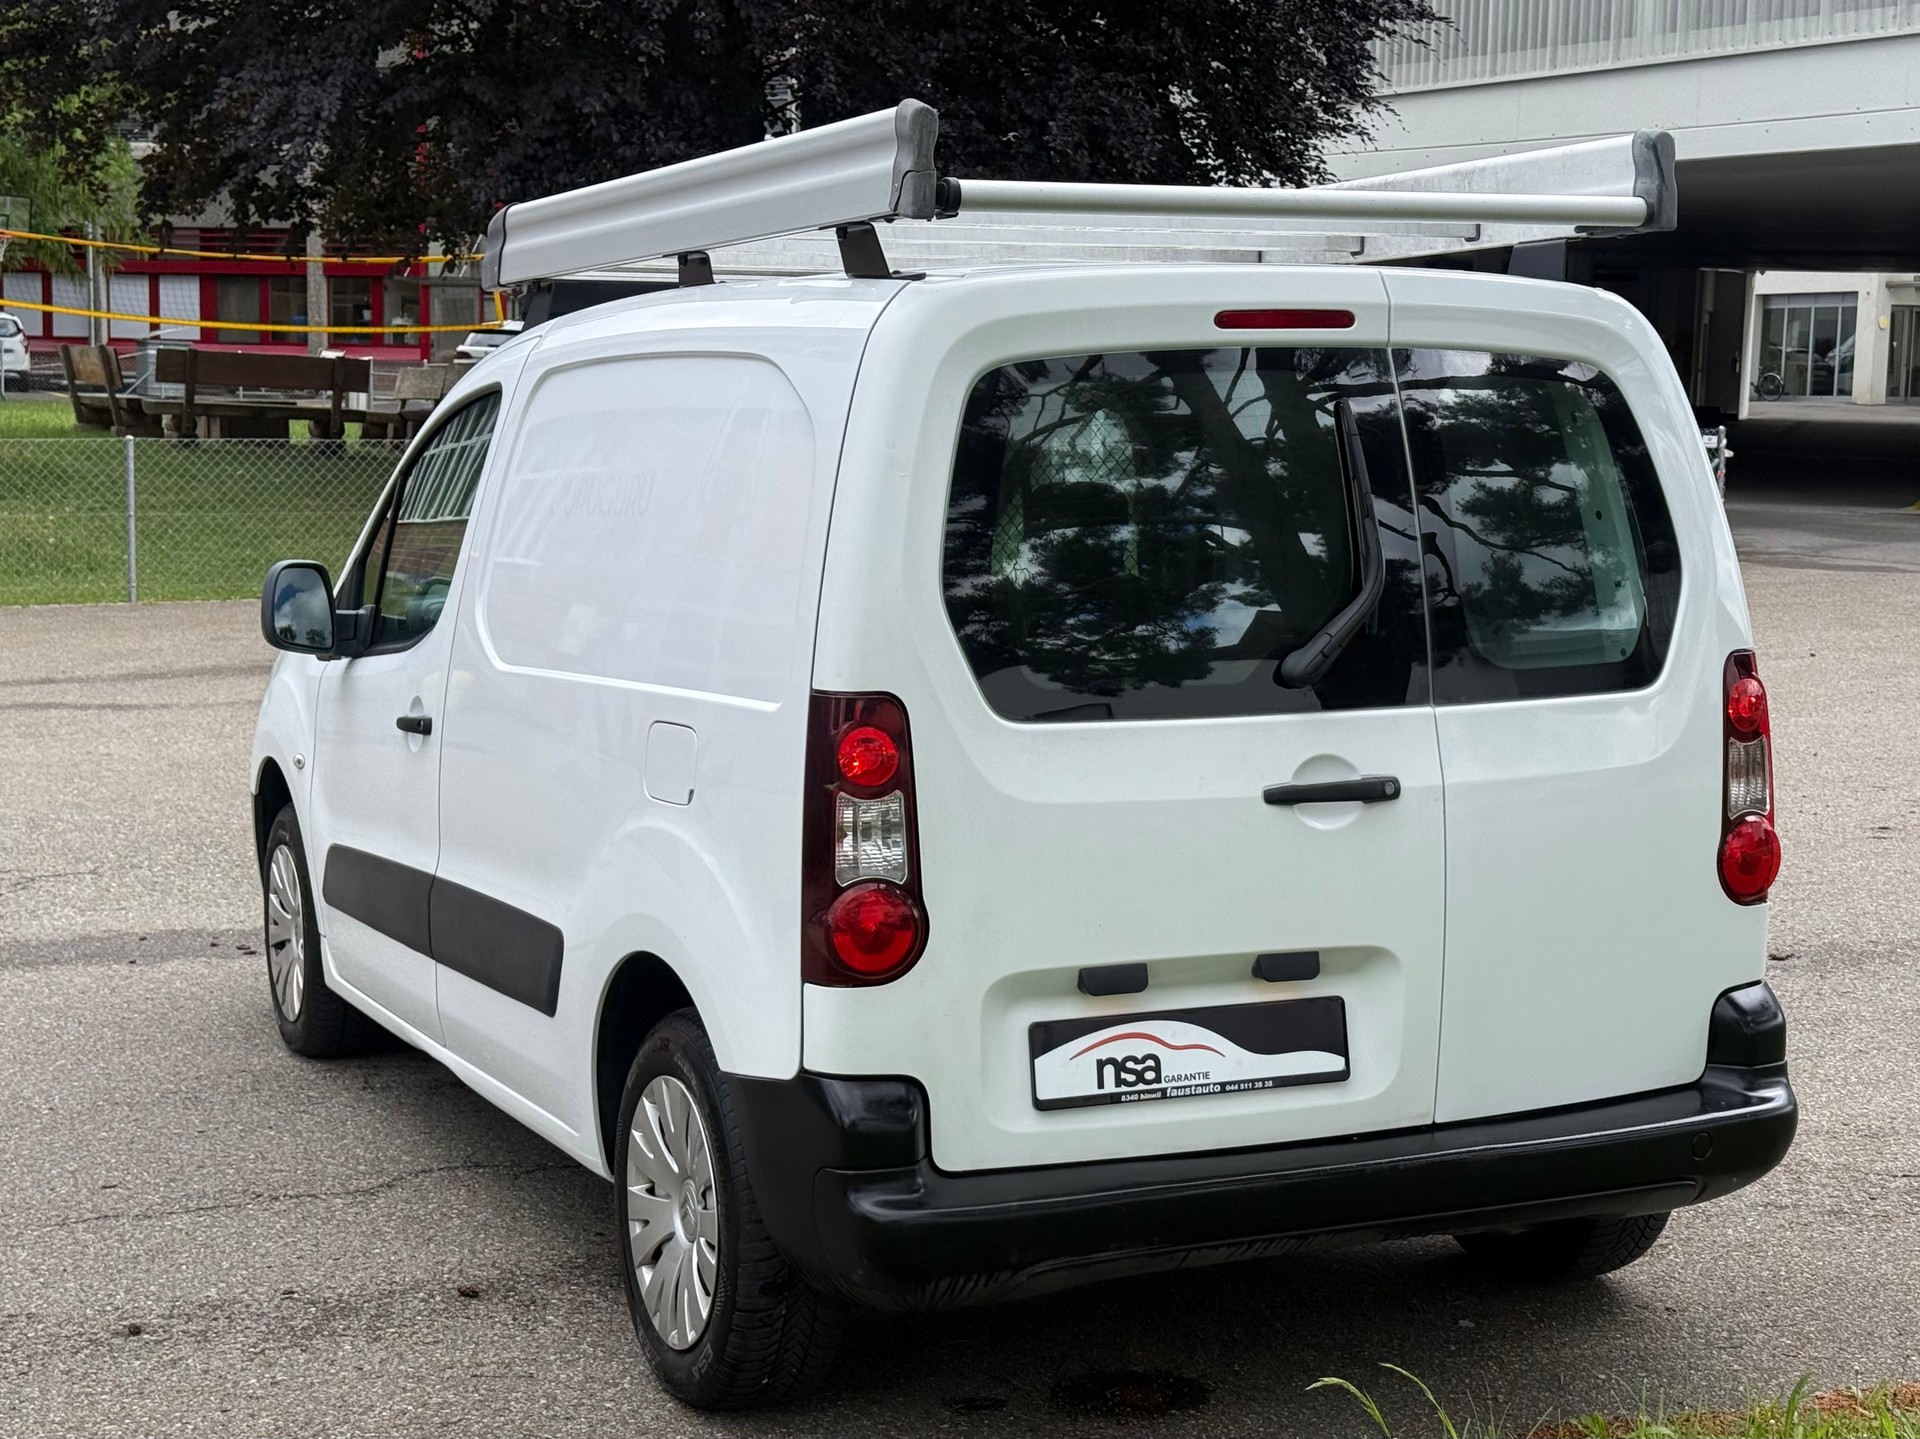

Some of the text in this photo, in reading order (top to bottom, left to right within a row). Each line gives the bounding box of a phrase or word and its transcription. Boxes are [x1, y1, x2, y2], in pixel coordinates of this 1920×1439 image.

[1096, 1053, 1162, 1089] nsa
[1163, 1071, 1211, 1084] GARANTIE
[1121, 1093, 1139, 1102] 8340
[1166, 1084, 1221, 1098] faustauto
[1225, 1083, 1239, 1091] 044
[1240, 1082, 1252, 1090] 511
[1253, 1081, 1263, 1089] 35
